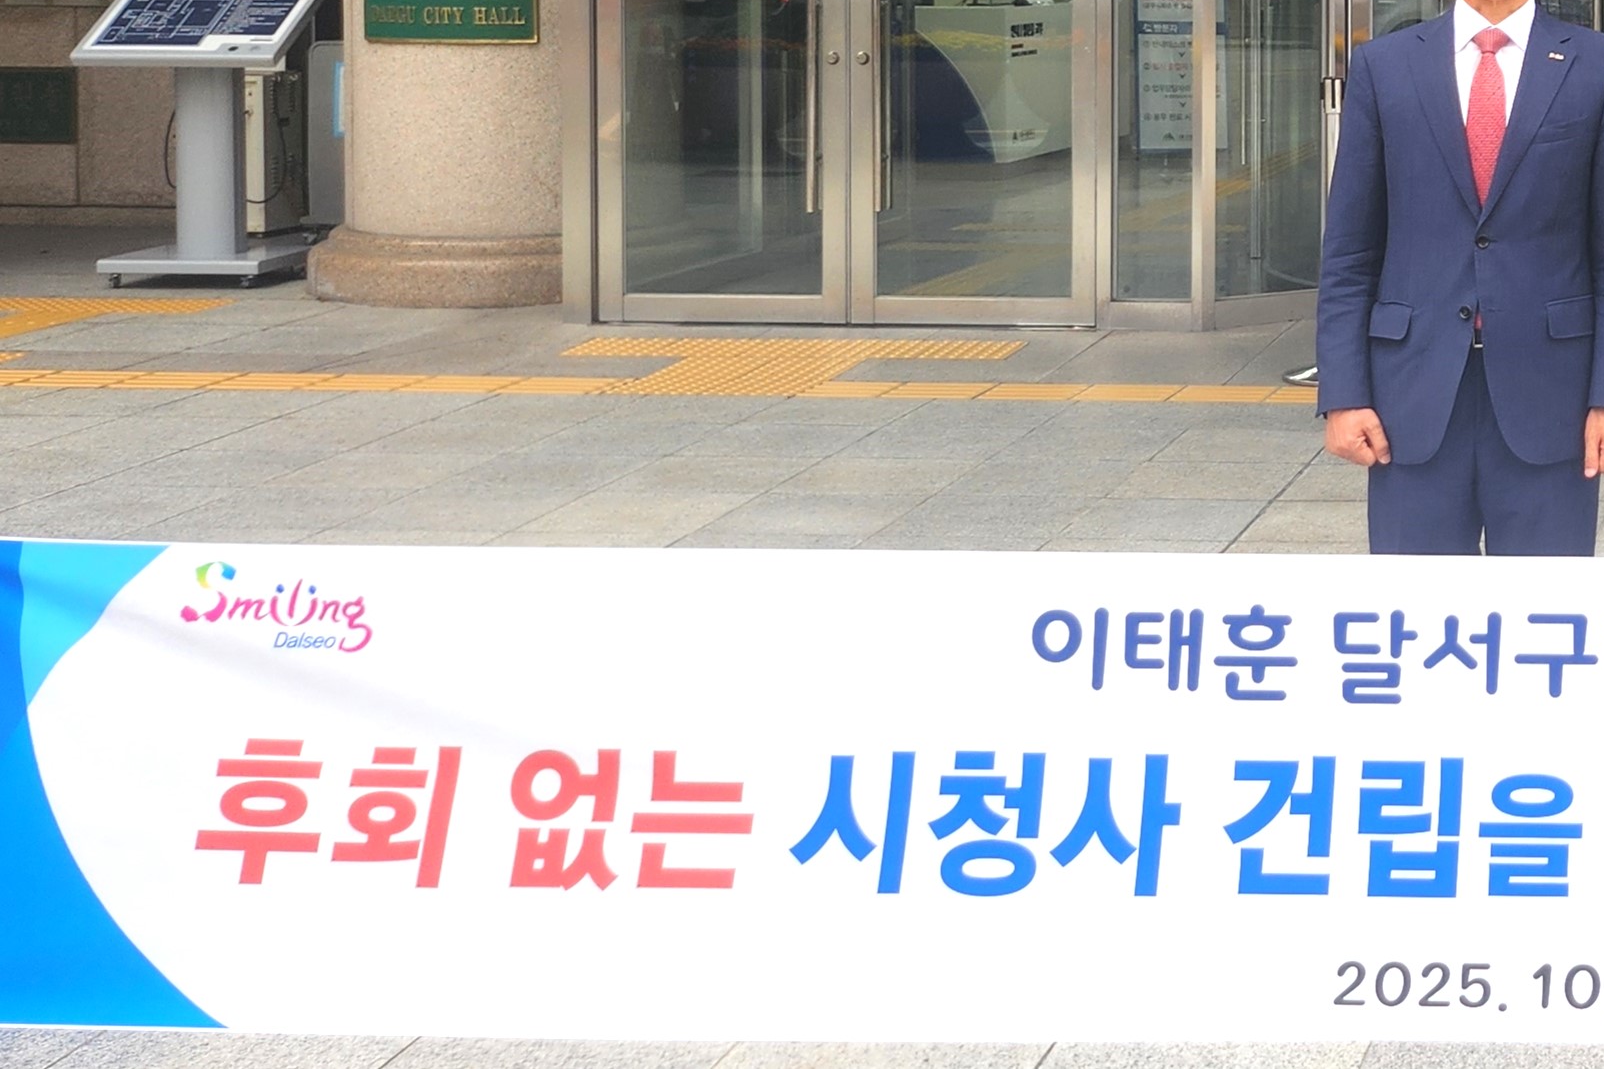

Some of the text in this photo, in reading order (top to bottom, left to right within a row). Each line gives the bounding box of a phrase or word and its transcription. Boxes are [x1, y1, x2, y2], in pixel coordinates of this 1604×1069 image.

[422, 6, 465, 25] CITY
[473, 6, 526, 25] HALL
[180, 560, 374, 653] Smiling
[273, 630, 337, 650] Dalseo
[1031, 604, 1298, 701] 이태훈
[195, 738, 463, 888] 후회
[509, 748, 754, 891] 없는
[789, 750, 1181, 897] 시청사
[1223, 755, 1583, 898] 건립을
[1333, 960, 1508, 1013] 2025.
